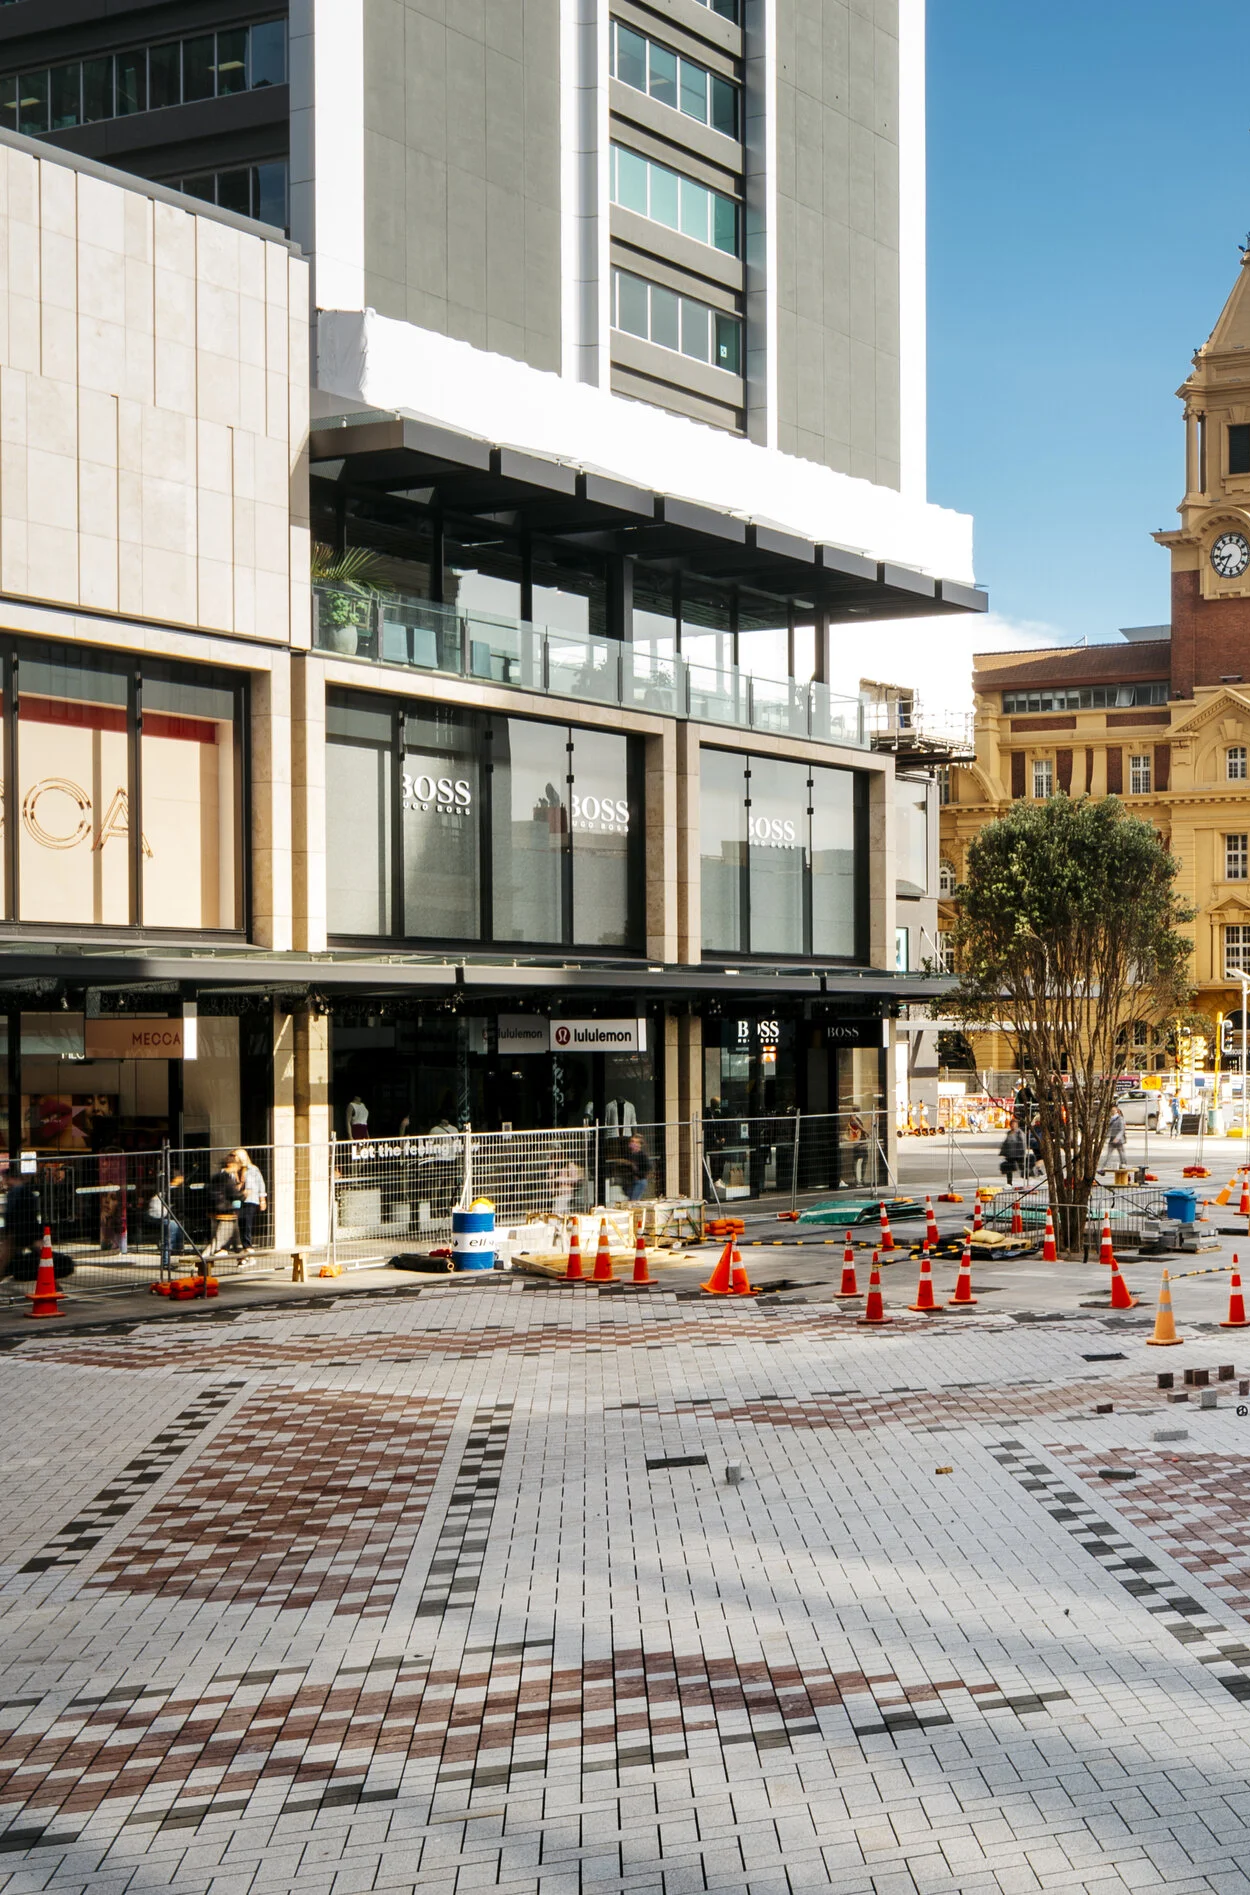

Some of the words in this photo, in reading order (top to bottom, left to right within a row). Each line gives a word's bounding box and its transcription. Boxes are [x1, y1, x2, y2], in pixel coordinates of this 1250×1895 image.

[403, 801, 428, 811] UGO
[0, 777, 153, 859] CA
[572, 820, 594, 828] UGO
[574, 1028, 632, 1042] lululemon
[737, 1020, 780, 1038] BSS
[827, 1026, 860, 1038] BOSS
[132, 1032, 181, 1046] MECCA
[351, 1144, 375, 1160] Let
[378, 1142, 401, 1158] the
[403, 1138, 450, 1158] feeling
